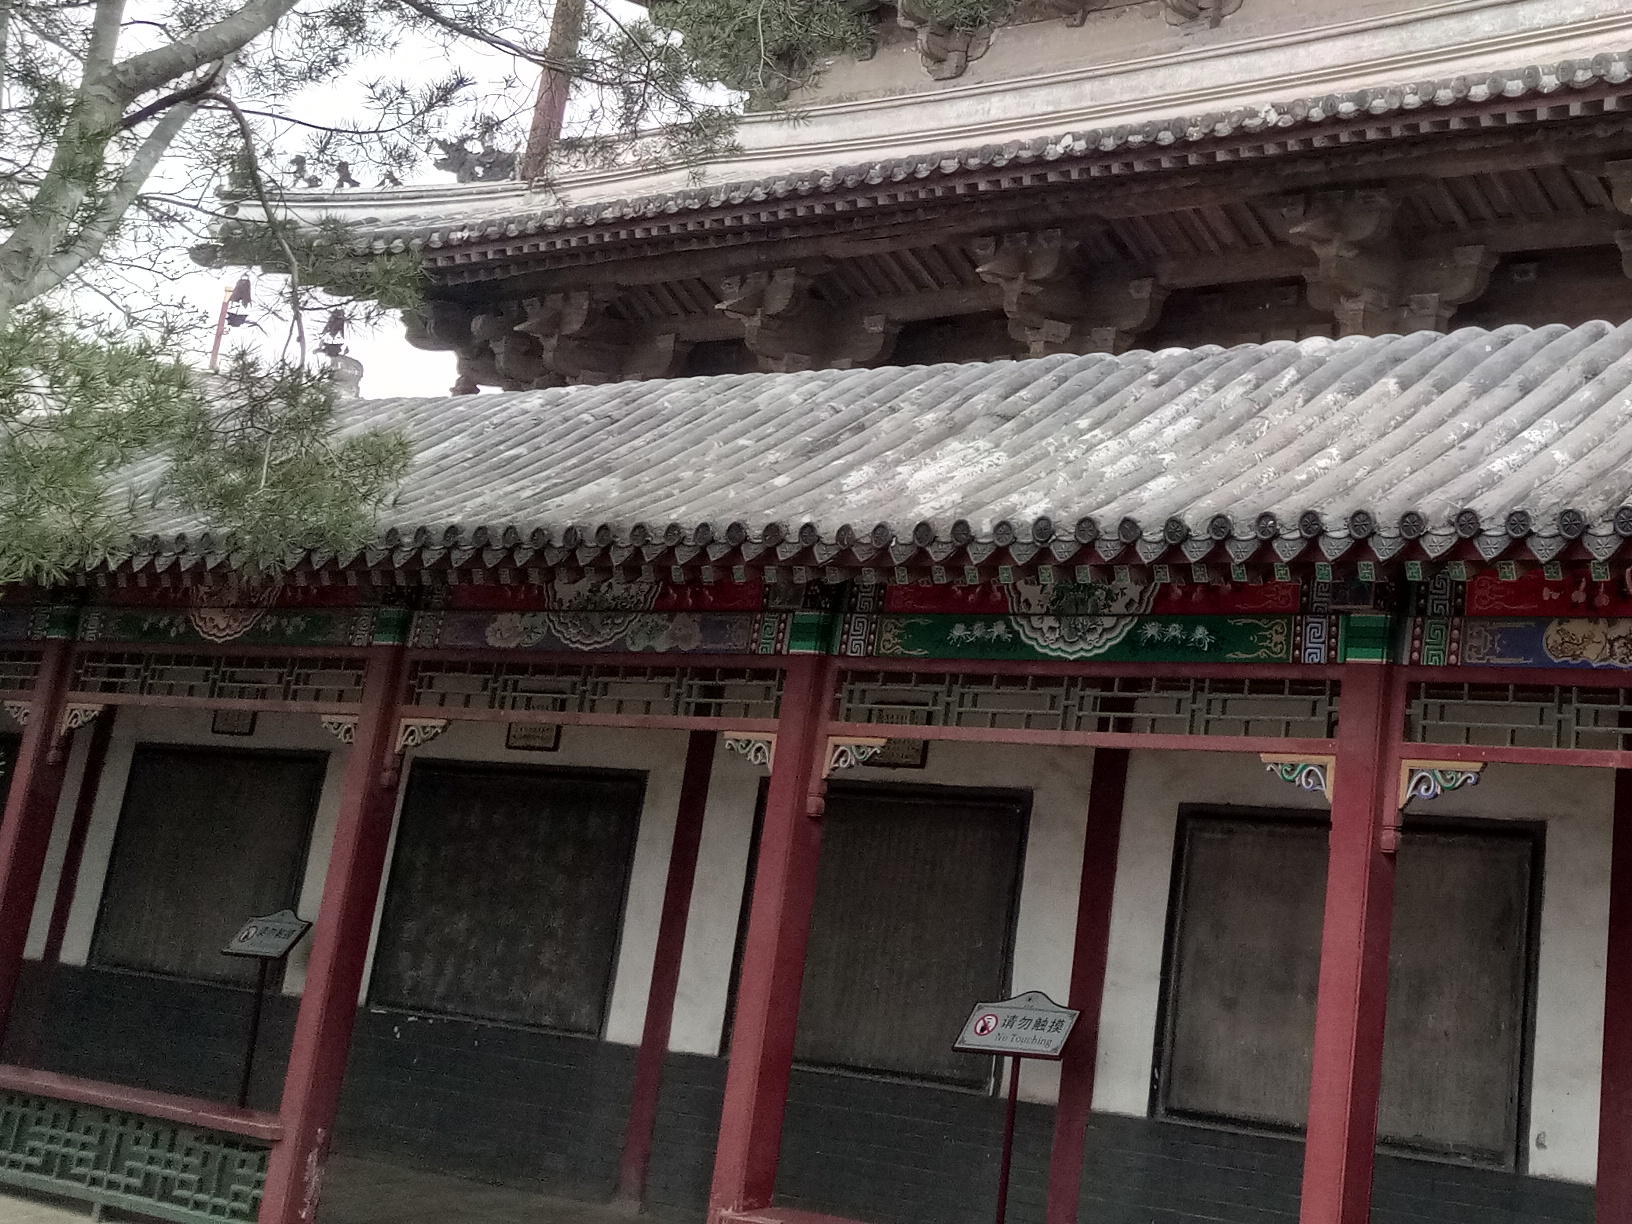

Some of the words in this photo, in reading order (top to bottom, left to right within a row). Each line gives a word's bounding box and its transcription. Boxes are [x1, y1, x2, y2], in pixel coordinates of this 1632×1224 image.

[1001, 1014, 1066, 1033] 请勿触摸
[995, 1033, 1008, 1042] No
[1010, 1034, 1053, 1048] Touching
